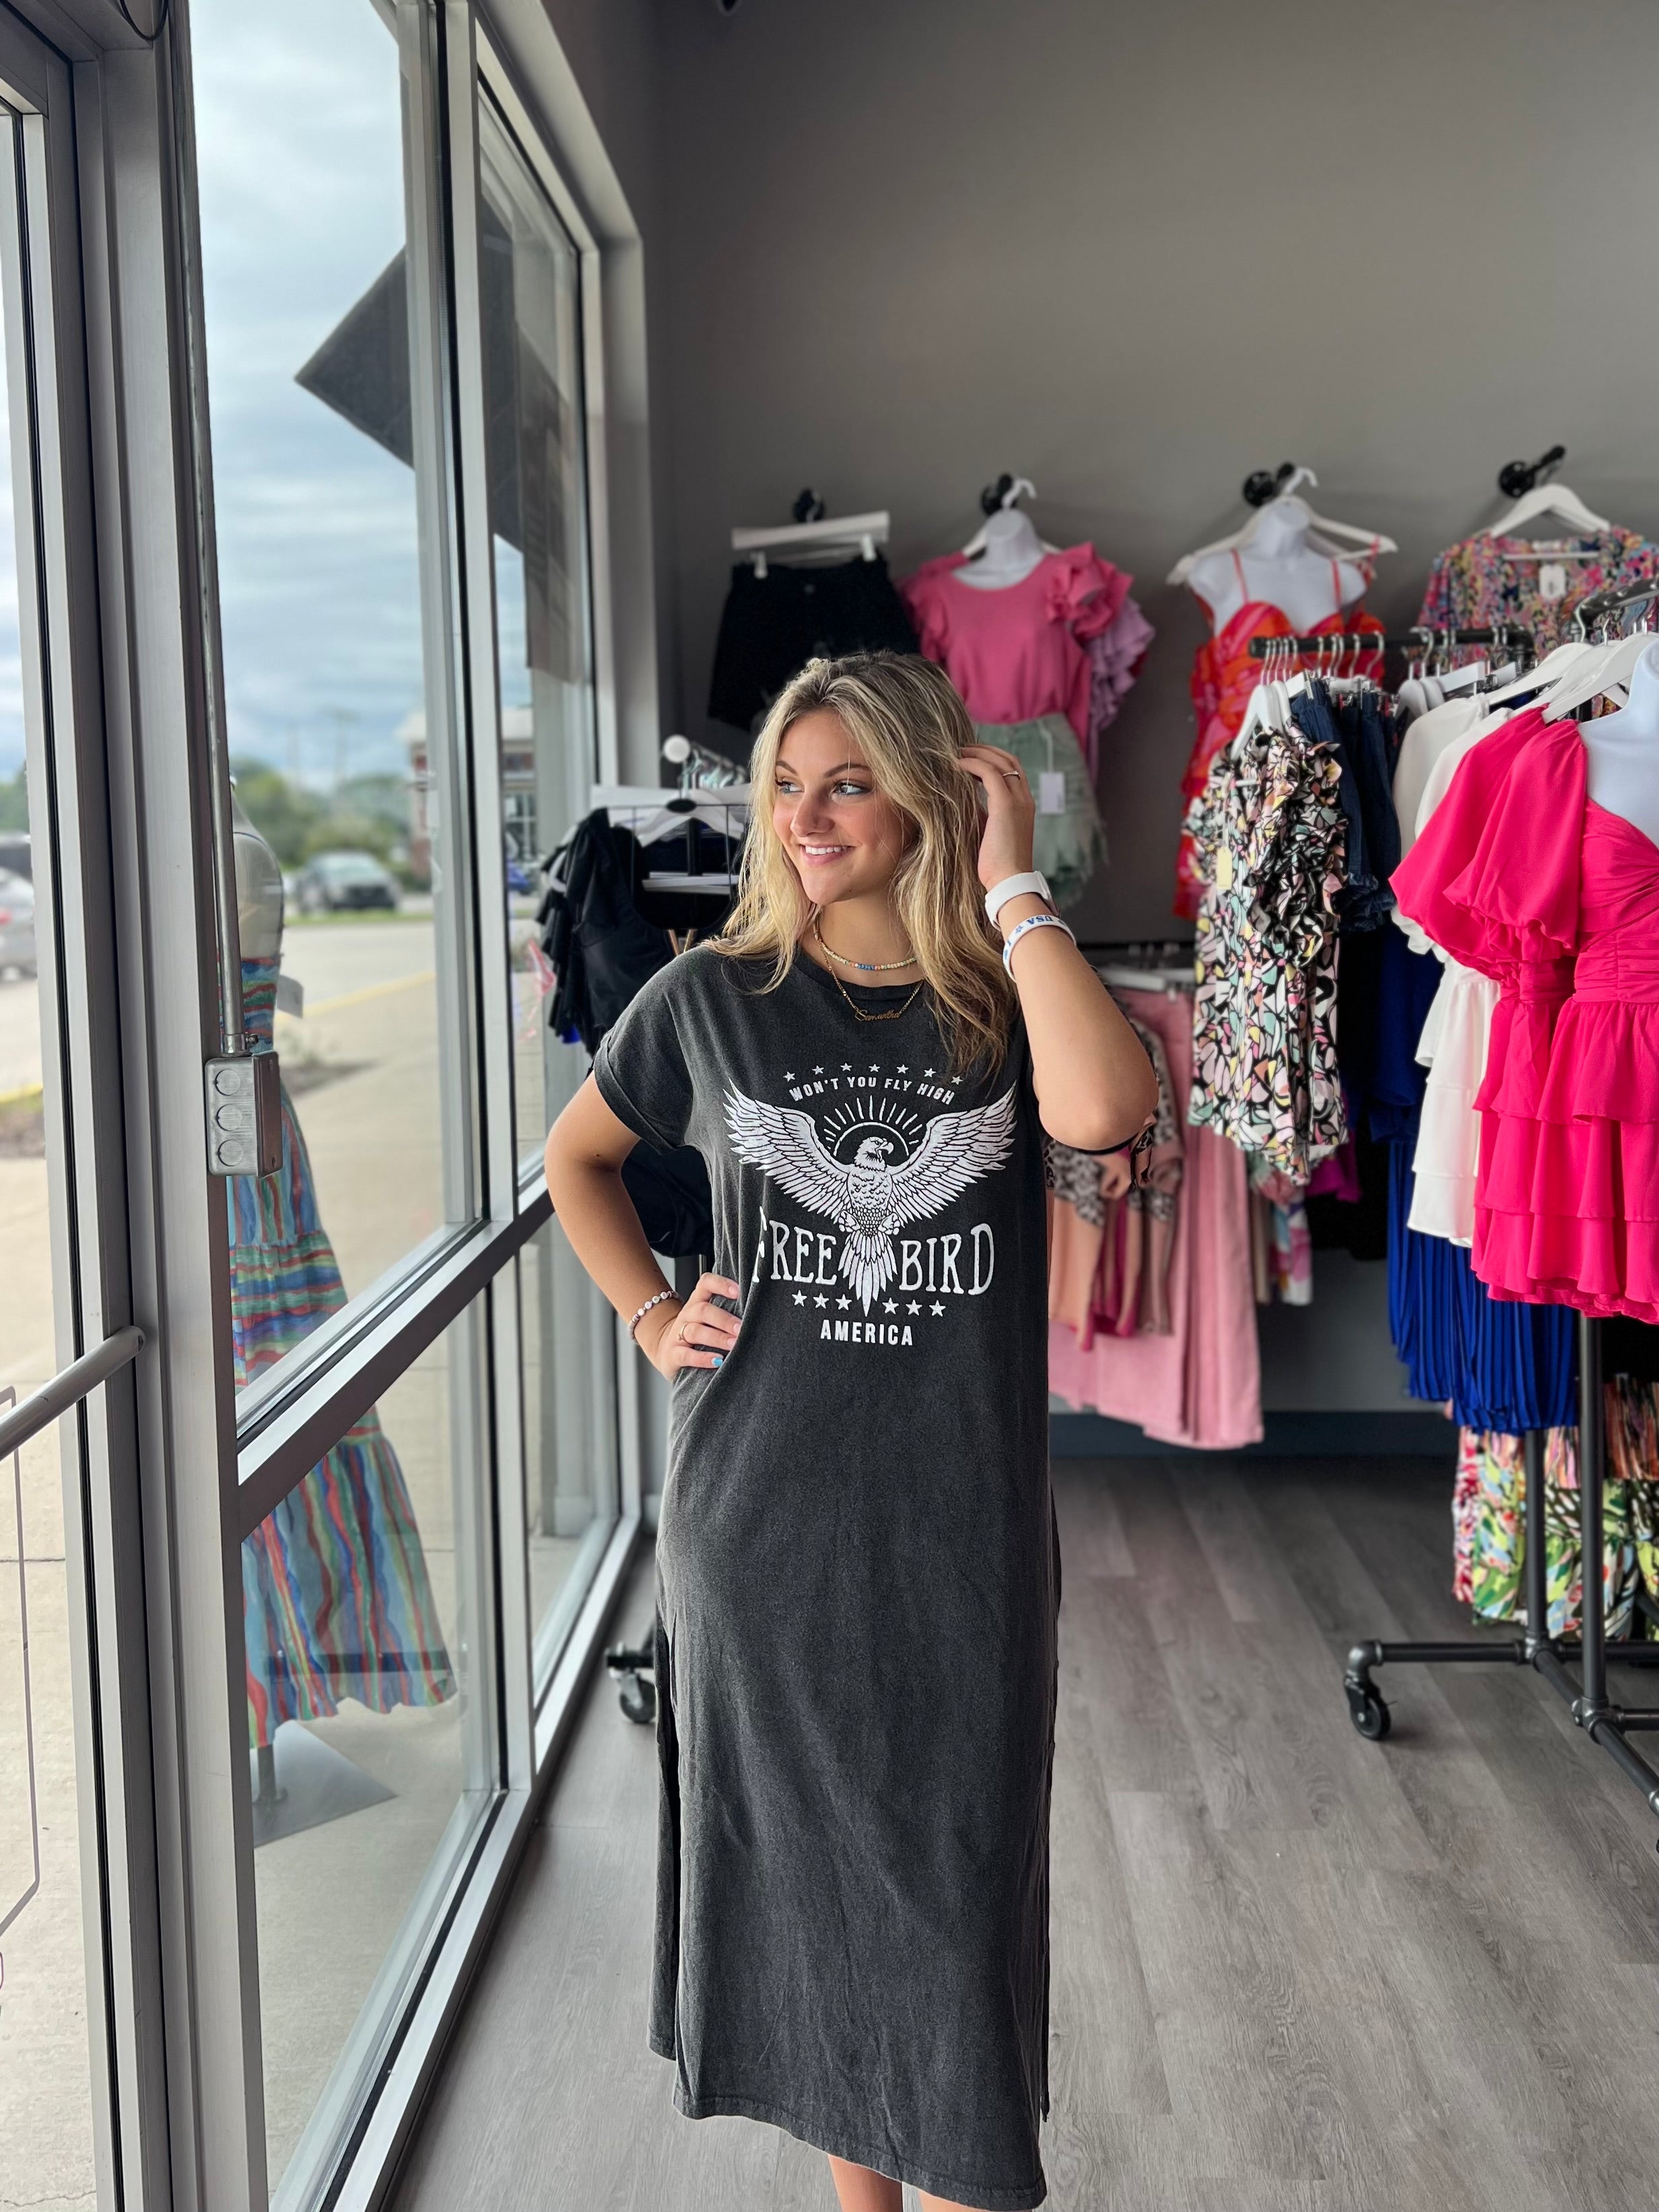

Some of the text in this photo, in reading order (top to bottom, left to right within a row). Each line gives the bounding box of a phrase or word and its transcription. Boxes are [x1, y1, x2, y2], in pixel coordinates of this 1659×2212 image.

[1026, 915, 1054, 925] USA
[789, 1076, 955, 1105] WON'T YOU FLY HIGH
[899, 1223, 994, 1295] BIRD
[820, 1319, 913, 1346] AMERICA
